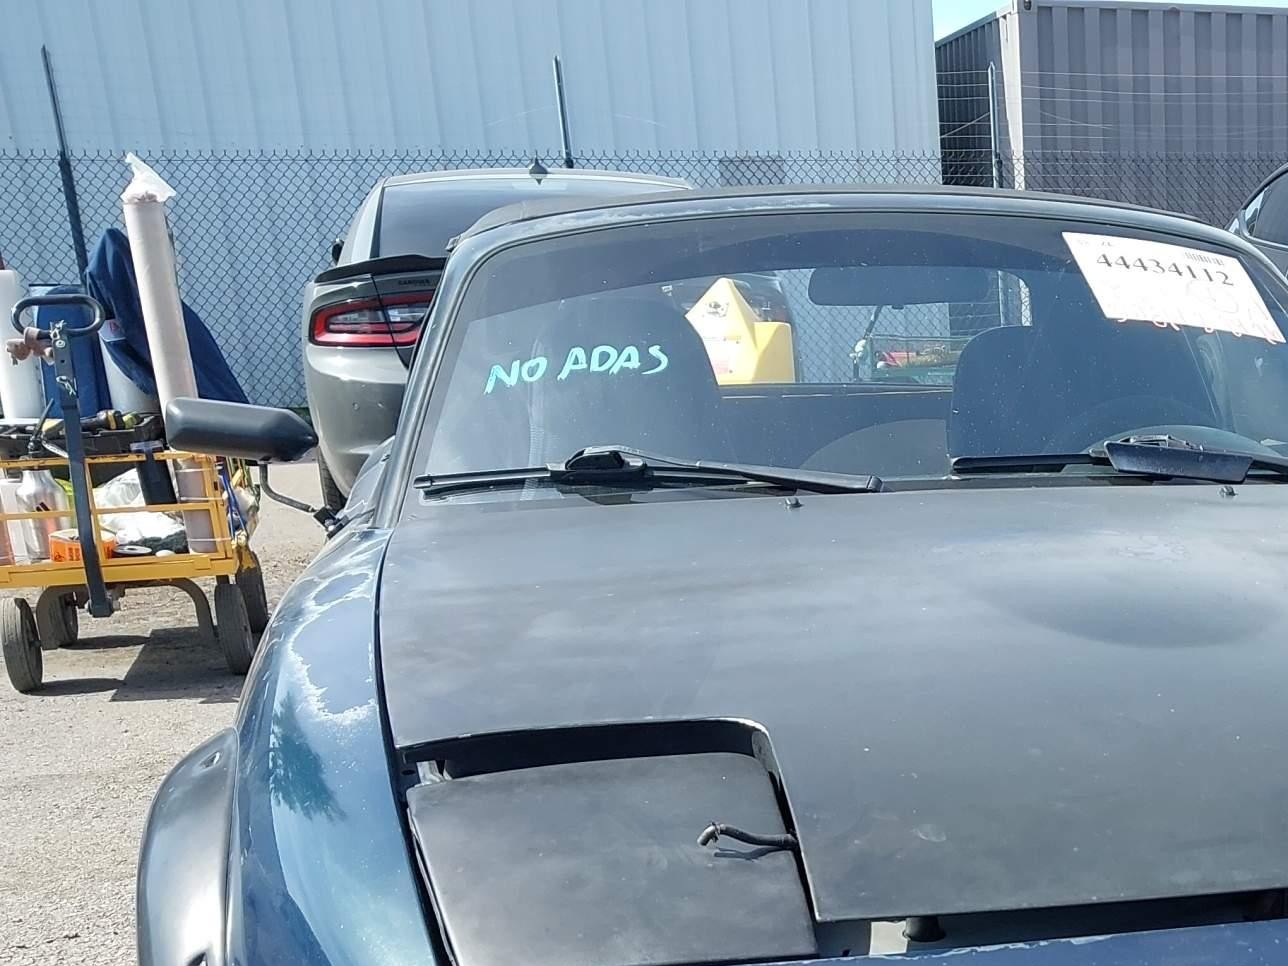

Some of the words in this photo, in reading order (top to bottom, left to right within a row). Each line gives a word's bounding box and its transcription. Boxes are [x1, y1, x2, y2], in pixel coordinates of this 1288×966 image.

[1097, 252, 1234, 286] 44434112
[484, 356, 547, 395] NO
[557, 344, 669, 381] ADAS
